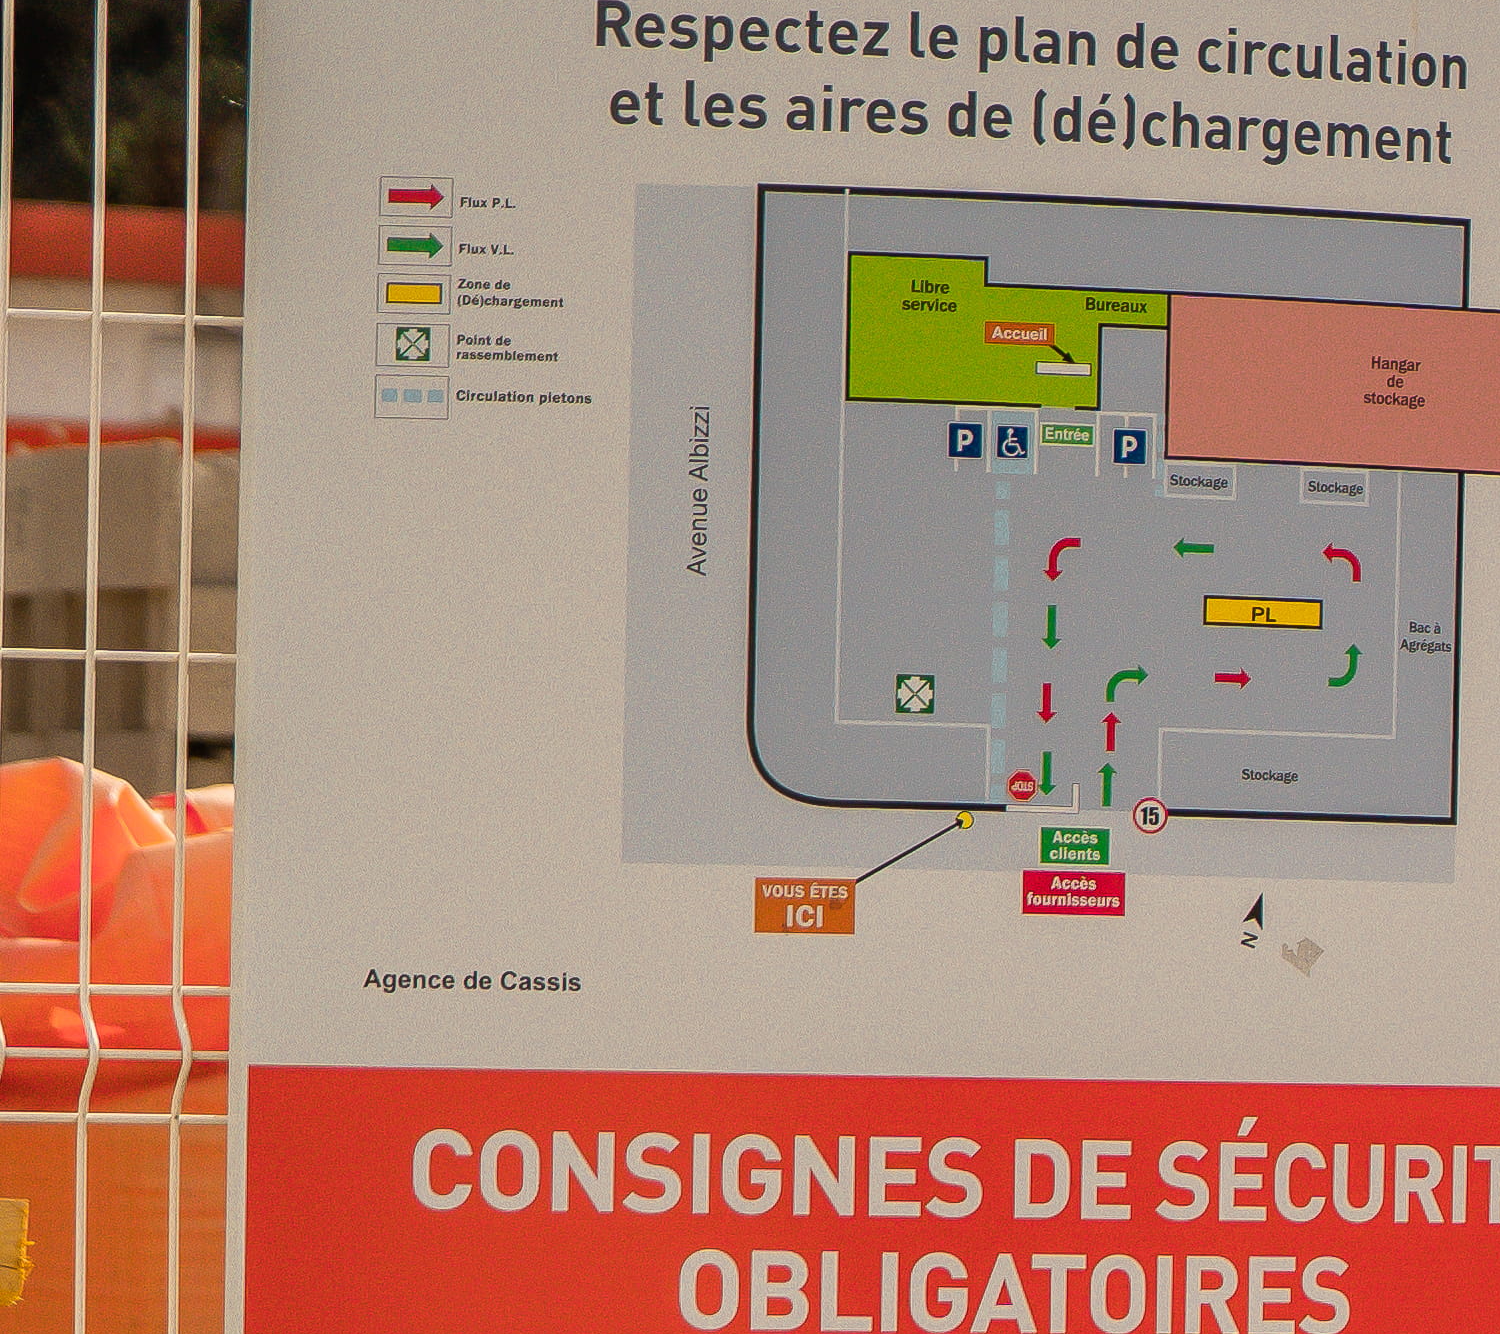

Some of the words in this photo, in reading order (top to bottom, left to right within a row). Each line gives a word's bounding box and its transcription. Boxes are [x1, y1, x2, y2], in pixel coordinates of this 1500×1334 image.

[597, 0, 889, 62] Respectez
[911, 12, 958, 59] le
[980, 16, 1095, 72] plan
[1117, 23, 1178, 70] de
[1198, 28, 1466, 89] circulation
[610, 83, 663, 125] et
[685, 80, 766, 129] les
[787, 85, 928, 135] aires
[949, 91, 1012, 138] de
[1034, 89, 1451, 165] (dé)chargement
[460, 197, 487, 208] Flux
[492, 198, 515, 208] P.L.
[459, 243, 486, 254] Flux
[491, 244, 514, 255] V.L.
[458, 278, 490, 289] Zone
[495, 280, 510, 290] de
[911, 280, 949, 294] Libre
[457, 295, 563, 309] (Dé)chargement
[902, 299, 957, 312] service
[1086, 297, 1146, 313] Bureaux
[457, 334, 491, 345] Point
[495, 336, 511, 346] de
[992, 326, 1048, 341] Accueil
[456, 350, 558, 362] rassemblement
[1372, 356, 1421, 374] Hangar
[1387, 375, 1403, 388] de
[456, 390, 534, 402] Circulation
[1364, 393, 1425, 409] stockage
[957, 430, 973, 451] P
[1045, 426, 1090, 442] Entrée
[689, 407, 709, 482] Albizzi
[1122, 436, 1137, 458] P
[1170, 474, 1228, 490] Stockage
[1308, 481, 1363, 496] Stockage
[687, 489, 709, 576] Avenue
[1252, 607, 1276, 623] PL
[1410, 622, 1430, 633] Bac
[1434, 623, 1441, 634] à
[1400, 639, 1451, 654] Agrégats
[1242, 769, 1298, 784] Stockage
[1141, 807, 1159, 825] 15
[1052, 830, 1098, 845] Accès
[1050, 846, 1100, 861] clients
[762, 883, 805, 898] VOUS
[810, 882, 849, 899] ÊTES
[1052, 877, 1095, 889] Accès
[1027, 892, 1120, 907] fournisseurs
[786, 904, 824, 928] ICI
[1241, 932, 1258, 948] N
[364, 969, 455, 993] Agence
[464, 971, 491, 990] de
[501, 971, 581, 991] Cassis
[413, 1129, 982, 1218] CONSIGNES
[1014, 1139, 1131, 1220] DE
